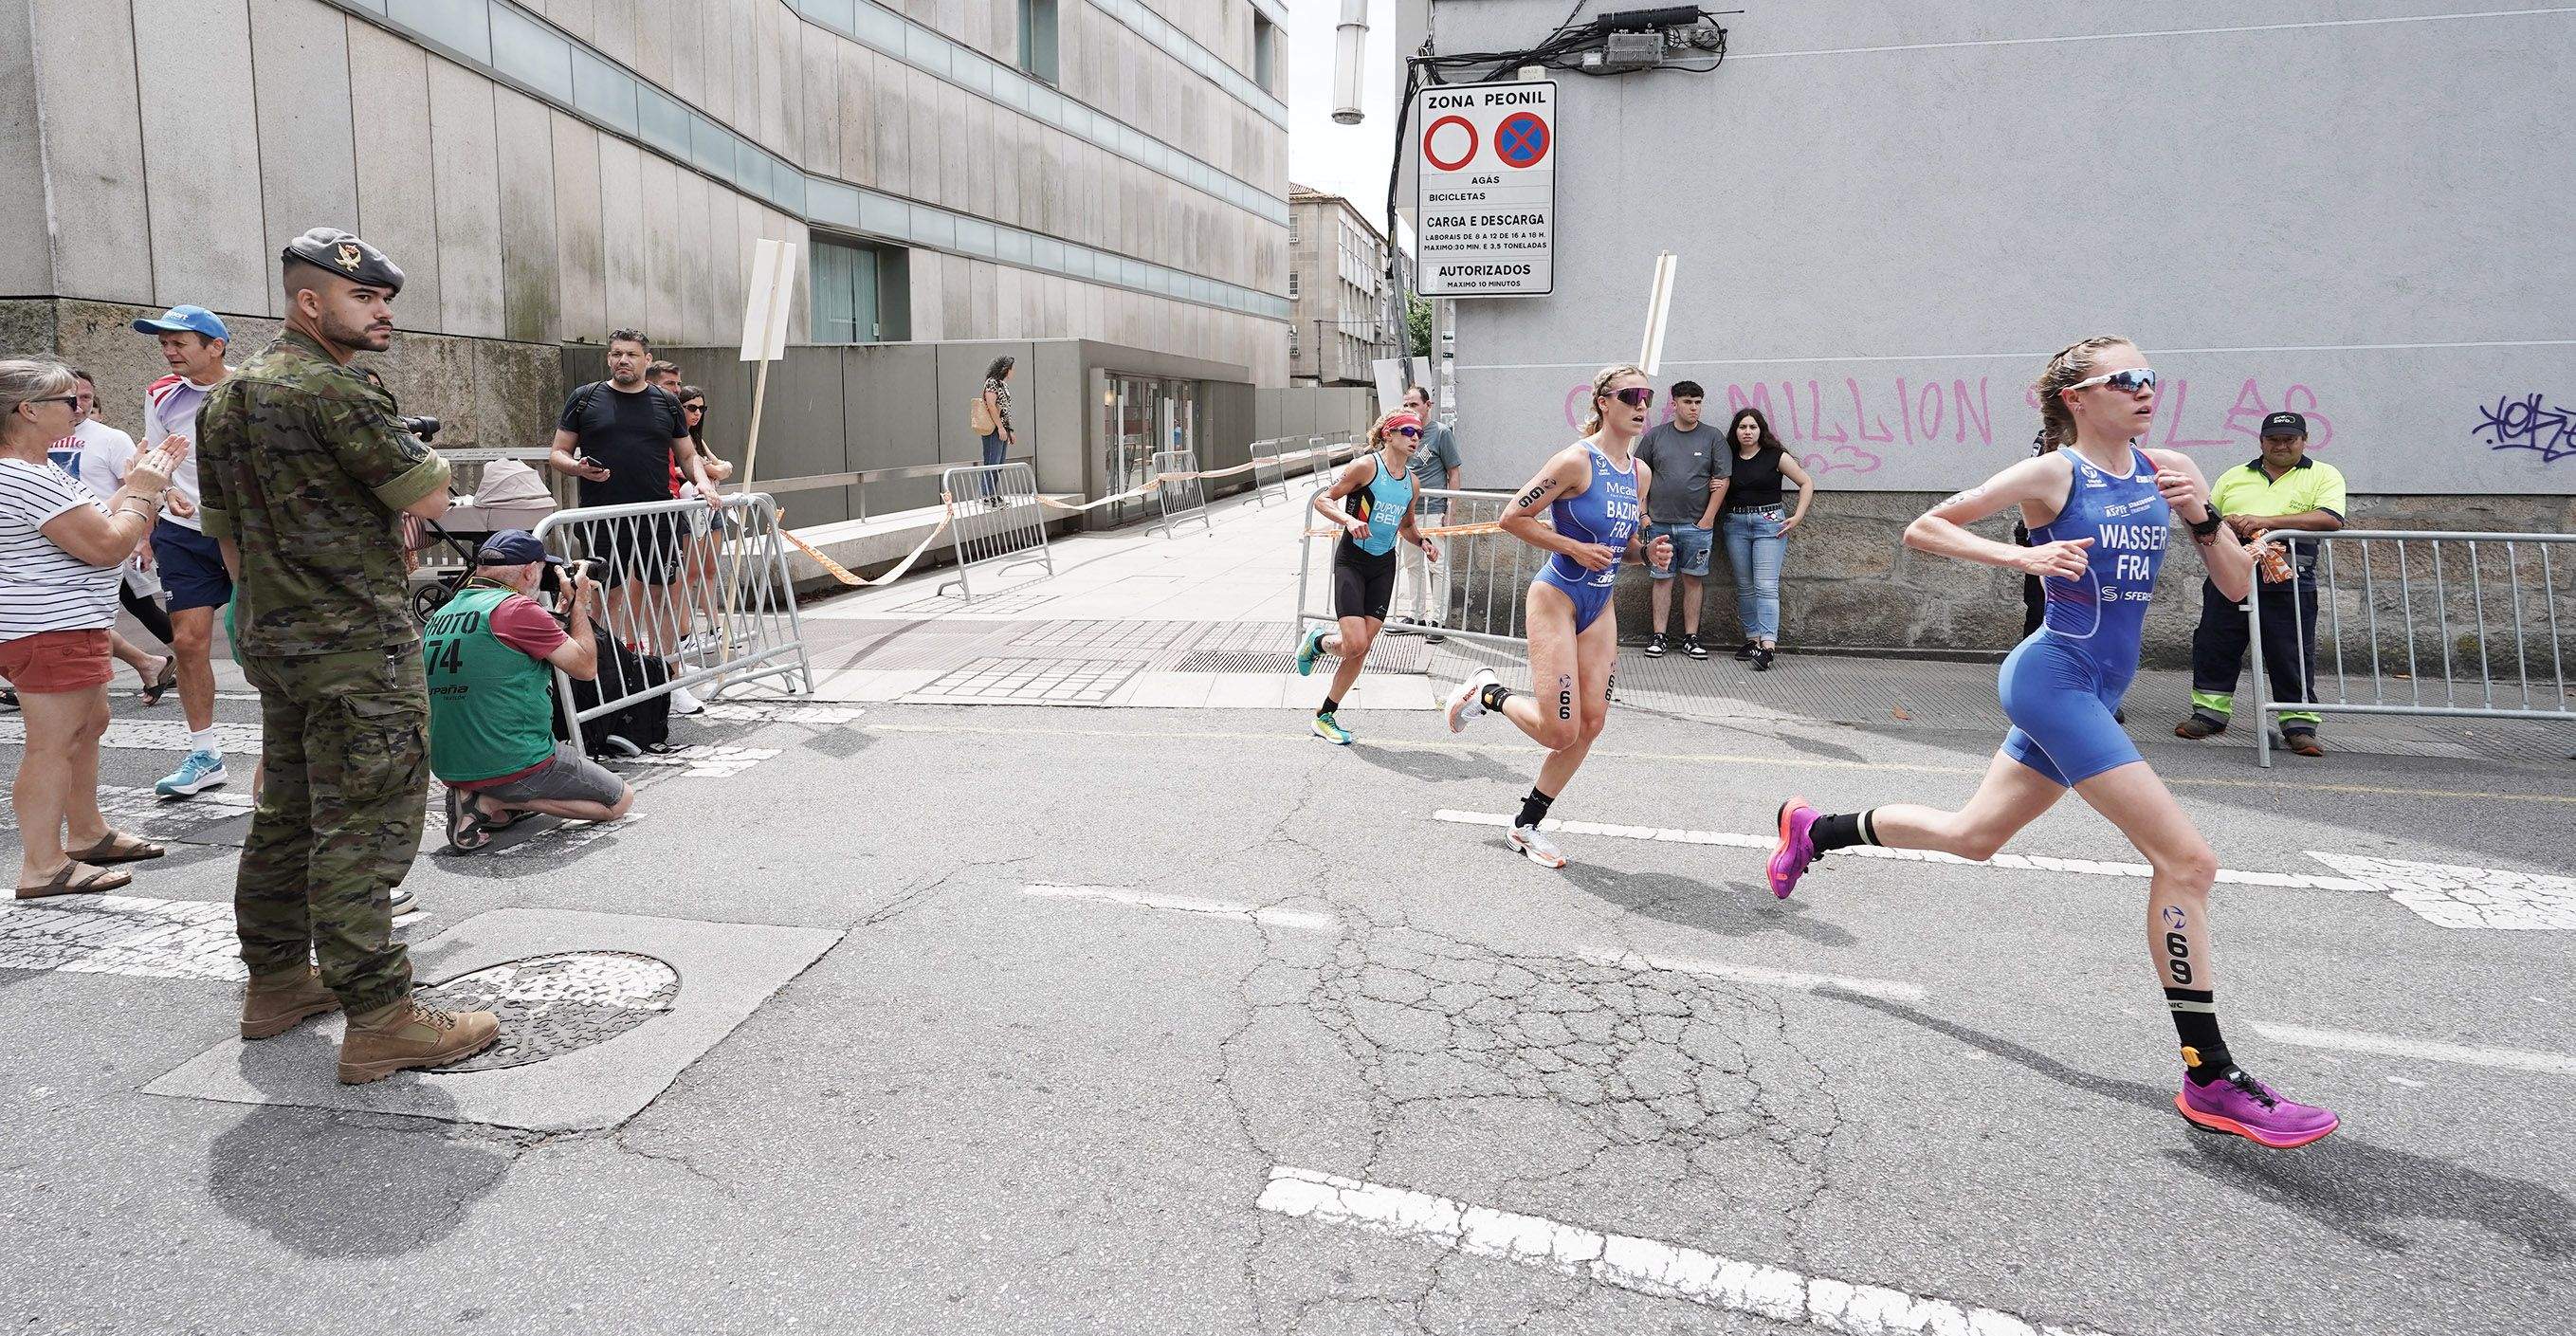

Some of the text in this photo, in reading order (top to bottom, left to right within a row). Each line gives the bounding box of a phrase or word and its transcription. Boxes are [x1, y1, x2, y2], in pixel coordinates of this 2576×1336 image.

[1428, 91, 1546, 109] ZONA PEONIL
[1471, 174, 1500, 185] AGÁS
[1429, 192, 1486, 202] BICICLETAS
[1427, 214, 1544, 228] CARGA E DESCARGA
[1439, 265, 1531, 277] AUTORIZADOS
[1606, 481, 1637, 498] Meau
[1374, 501, 1407, 516] DUPONT
[1606, 500, 1639, 522] BAZIR
[1375, 512, 1398, 526] BEL
[1610, 522, 1632, 540] FRA
[2098, 523, 2167, 550] WASSER
[2116, 555, 2149, 580] FRA
[426, 610, 481, 637] PHOTO
[423, 638, 464, 676] 74
[1605, 674, 1615, 701] 66
[1559, 690, 1571, 720] 66
[2166, 932, 2192, 985] 69
